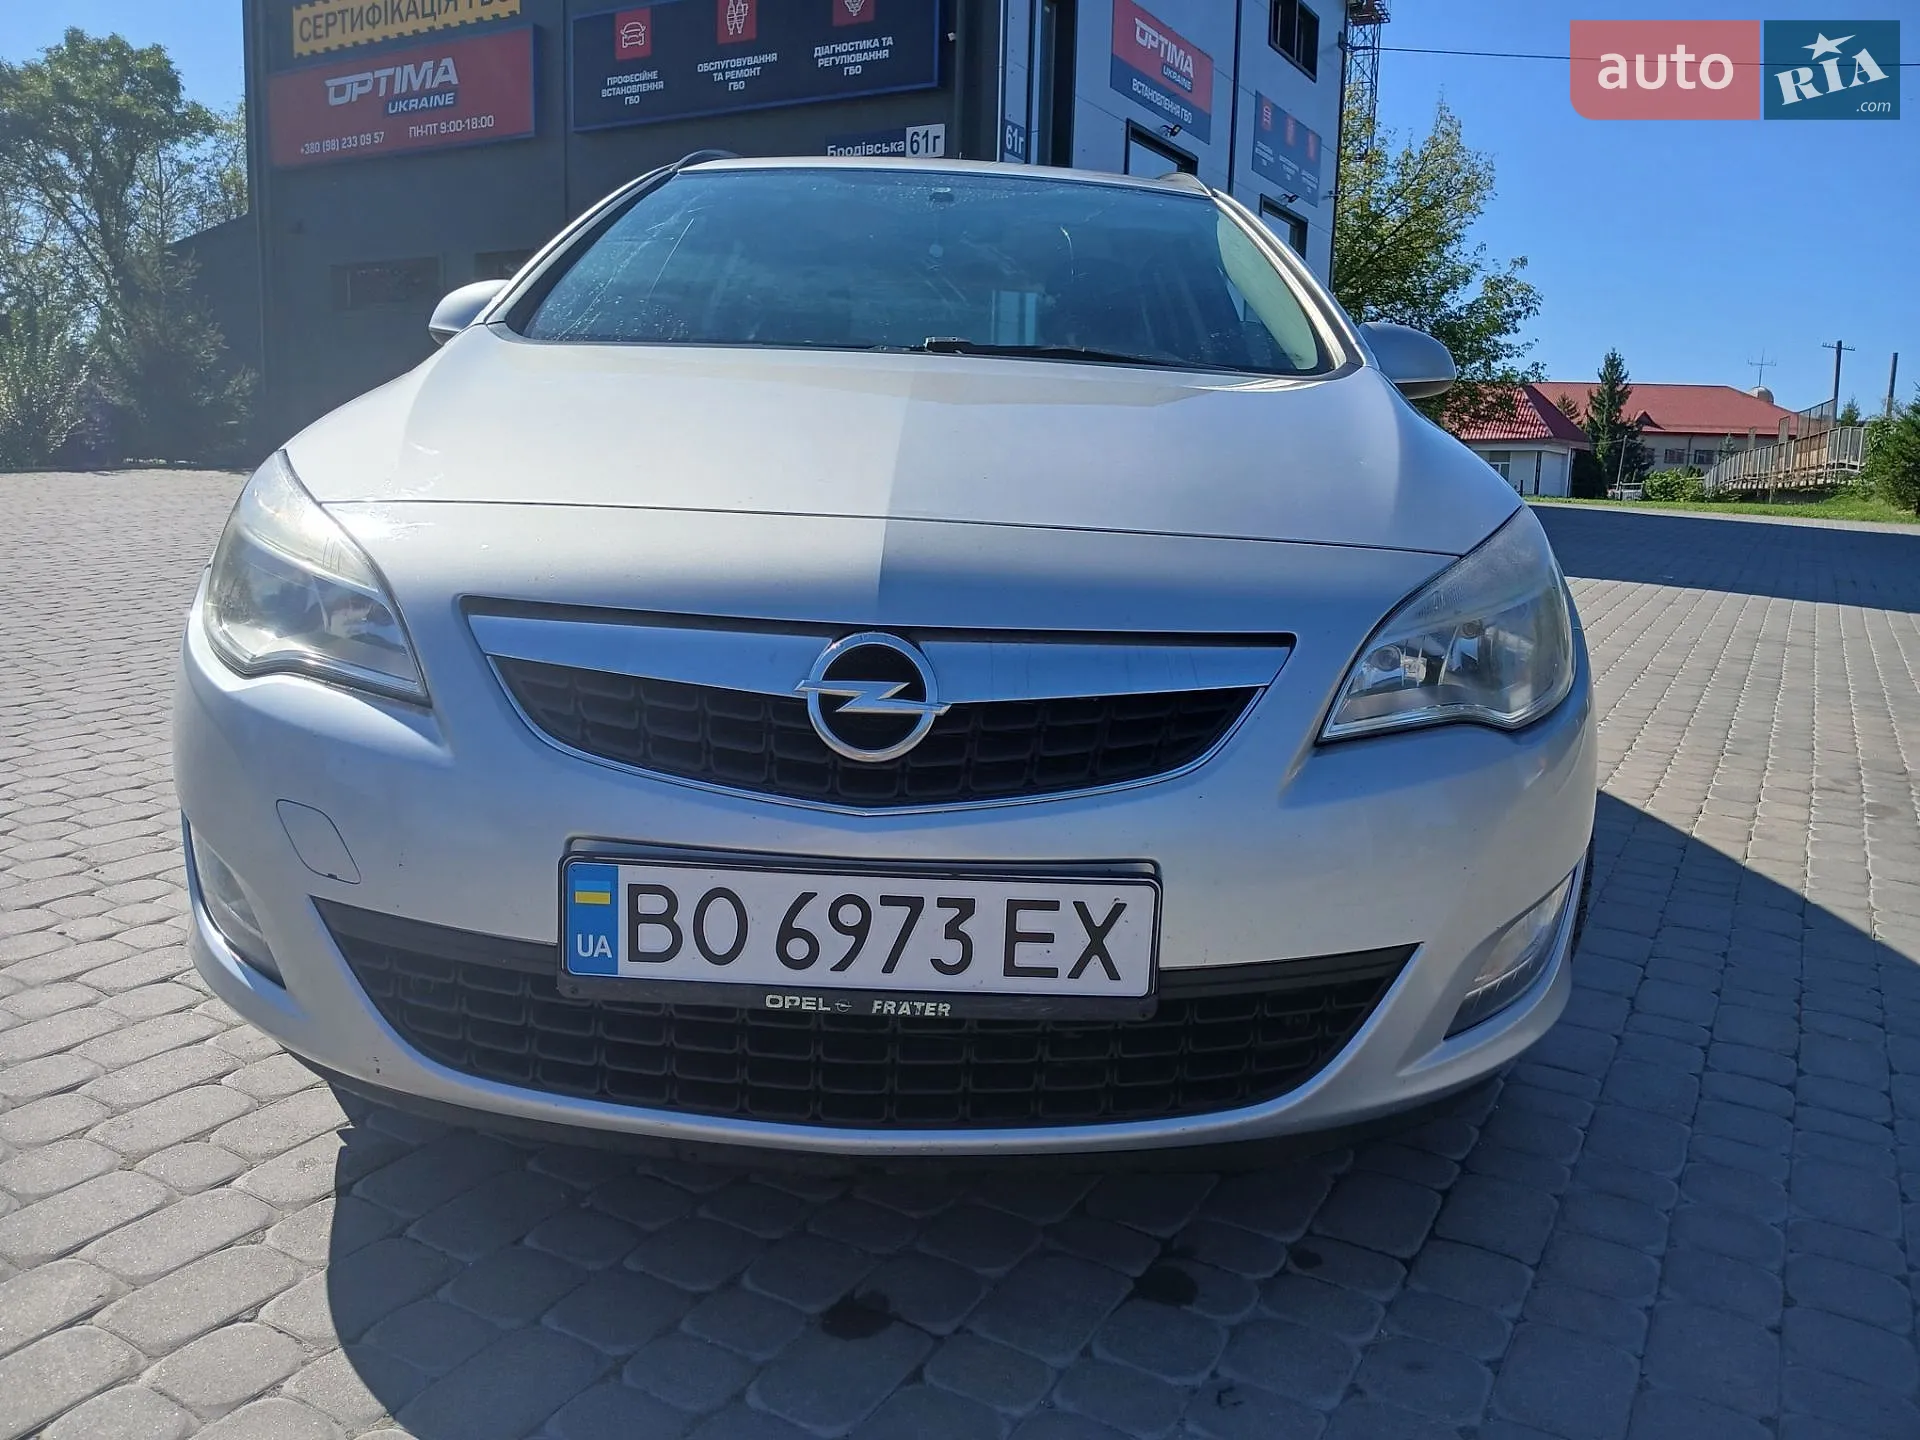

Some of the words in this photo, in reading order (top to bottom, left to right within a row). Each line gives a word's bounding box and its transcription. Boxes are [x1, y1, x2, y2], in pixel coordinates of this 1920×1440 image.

[813, 38, 880, 58] ДІАГНОСТИКА
[881, 36, 894, 47] ТА
[1135, 17, 1194, 79] OPTIMA
[697, 52, 778, 73] ОБСЛУГОВУВАННЯ
[818, 49, 889, 68] РЕГУЛЮВАННЯ
[324, 56, 459, 106] OPTIMA
[606, 70, 658, 86] ПРОФЕСІЙНЕ
[713, 72, 724, 82] ТА
[725, 66, 762, 80] РЕМОНТ
[843, 65, 862, 76] ГБО
[1162, 65, 1193, 91] UKRAINE
[601, 80, 664, 98] ВСТАНОВЛЕННЯ
[728, 80, 745, 92] ГБО
[388, 92, 455, 114] UKRAINE
[624, 95, 640, 105] ГБО
[1131, 78, 1181, 117] ВСТАНОВЛЕННЯ
[1180, 106, 1193, 124] ГБО
[409, 123, 438, 138] ПН-ПТ
[440, 115, 495, 134] 9:00-18:00
[301, 142, 321, 155] +380
[341, 136, 358, 149] 233
[360, 133, 373, 146] 09
[373, 131, 385, 144] 57
[627, 883, 748, 966] BO
[775, 891, 976, 976] 6973
[1003, 898, 1127, 981] EX
[577, 933, 613, 958] UA
[765, 994, 831, 1012] OPEL
